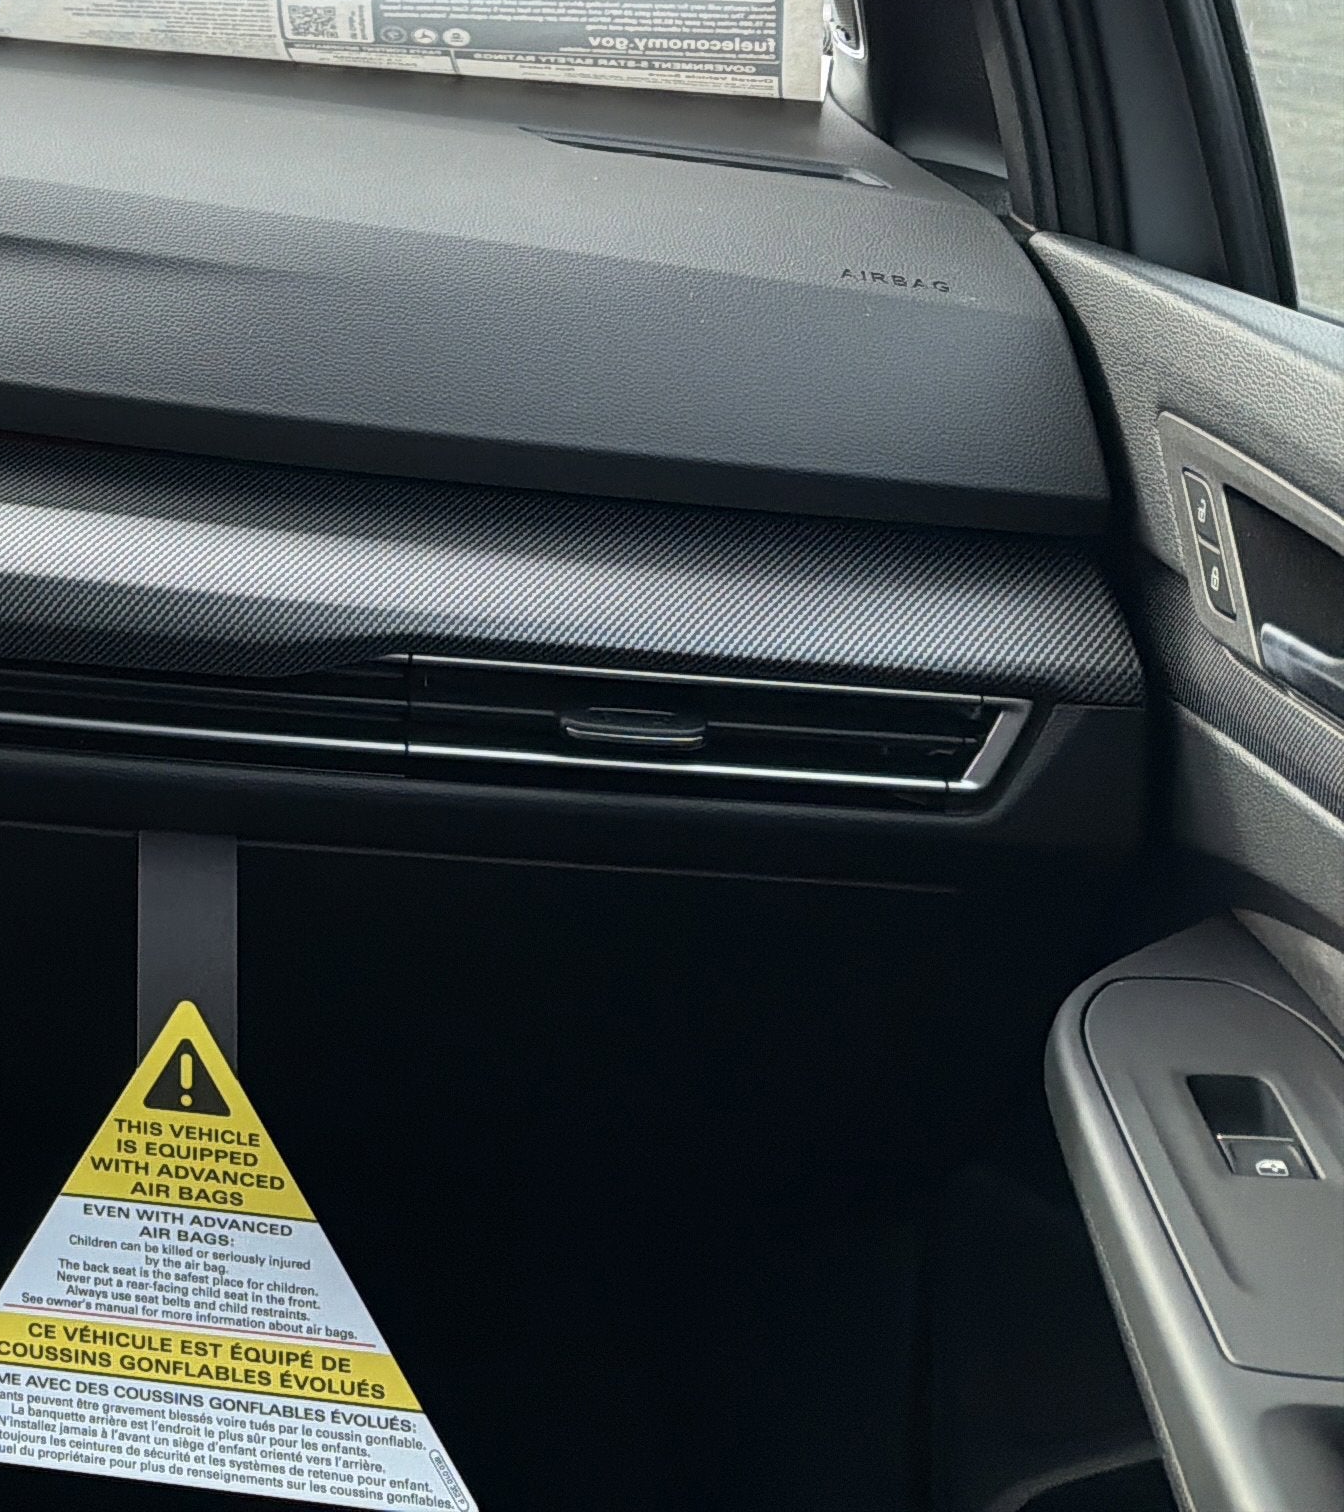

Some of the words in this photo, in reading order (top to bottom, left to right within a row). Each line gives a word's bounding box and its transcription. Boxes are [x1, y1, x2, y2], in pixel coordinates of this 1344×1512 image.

[839, 266, 952, 294] AIRBAG
[112, 1119, 163, 1137] THIS
[168, 1124, 261, 1147] VEHICLE
[116, 1139, 138, 1154] IS
[144, 1142, 259, 1167] EQUIPPED
[89, 1156, 150, 1176] WITH
[156, 1163, 285, 1190] ADVANCED
[130, 1181, 170, 1198] AIR
[177, 1186, 244, 1206] BAGS
[82, 1204, 130, 1220] EVEN
[135, 1209, 184, 1225] WITH
[189, 1215, 293, 1236] ADVANCED
[138, 1226, 172, 1240] AIR
[176, 1230, 235, 1246] BAGS:
[68, 1235, 118, 1250] Children
[120, 1243, 142, 1253] can
[144, 1243, 160, 1255] be
[162, 1245, 194, 1258] killed
[196, 1250, 209, 1260] or
[211, 1251, 266, 1268] seriously
[268, 1255, 312, 1270] injured
[144, 1255, 160, 1270] by
[162, 1257, 182, 1269] the
[184, 1260, 200, 1271] air
[203, 1261, 230, 1276] bag.
[58, 1259, 80, 1271] The
[82, 1261, 110, 1274] back
[112, 1266, 137, 1277] seat
[152, 1268, 172, 1281] the
[174, 1272, 210, 1285] safest
[212, 1275, 244, 1289] place
[246, 1278, 265, 1291] for
[266, 1281, 320, 1296] children.
[27, 1323, 57, 1340] CE
[62, 1325, 173, 1353] VÉHICULE
[179, 1340, 222, 1358] EST
[229, 1342, 314, 1369] ÉQUIPÉ
[320, 1356, 352, 1373] DE
[118, 1356, 272, 1386] GONFLABLES
[278, 1370, 386, 1399] ÉVOLUÉS
[25, 1376, 72, 1392] AVEC
[74, 1382, 110, 1396] DES
[113, 1386, 205, 1408] COUSSINS
[208, 1397, 326, 1422] GONFLABLES
[330, 1409, 417, 1433] ÉVOLUÉS:
